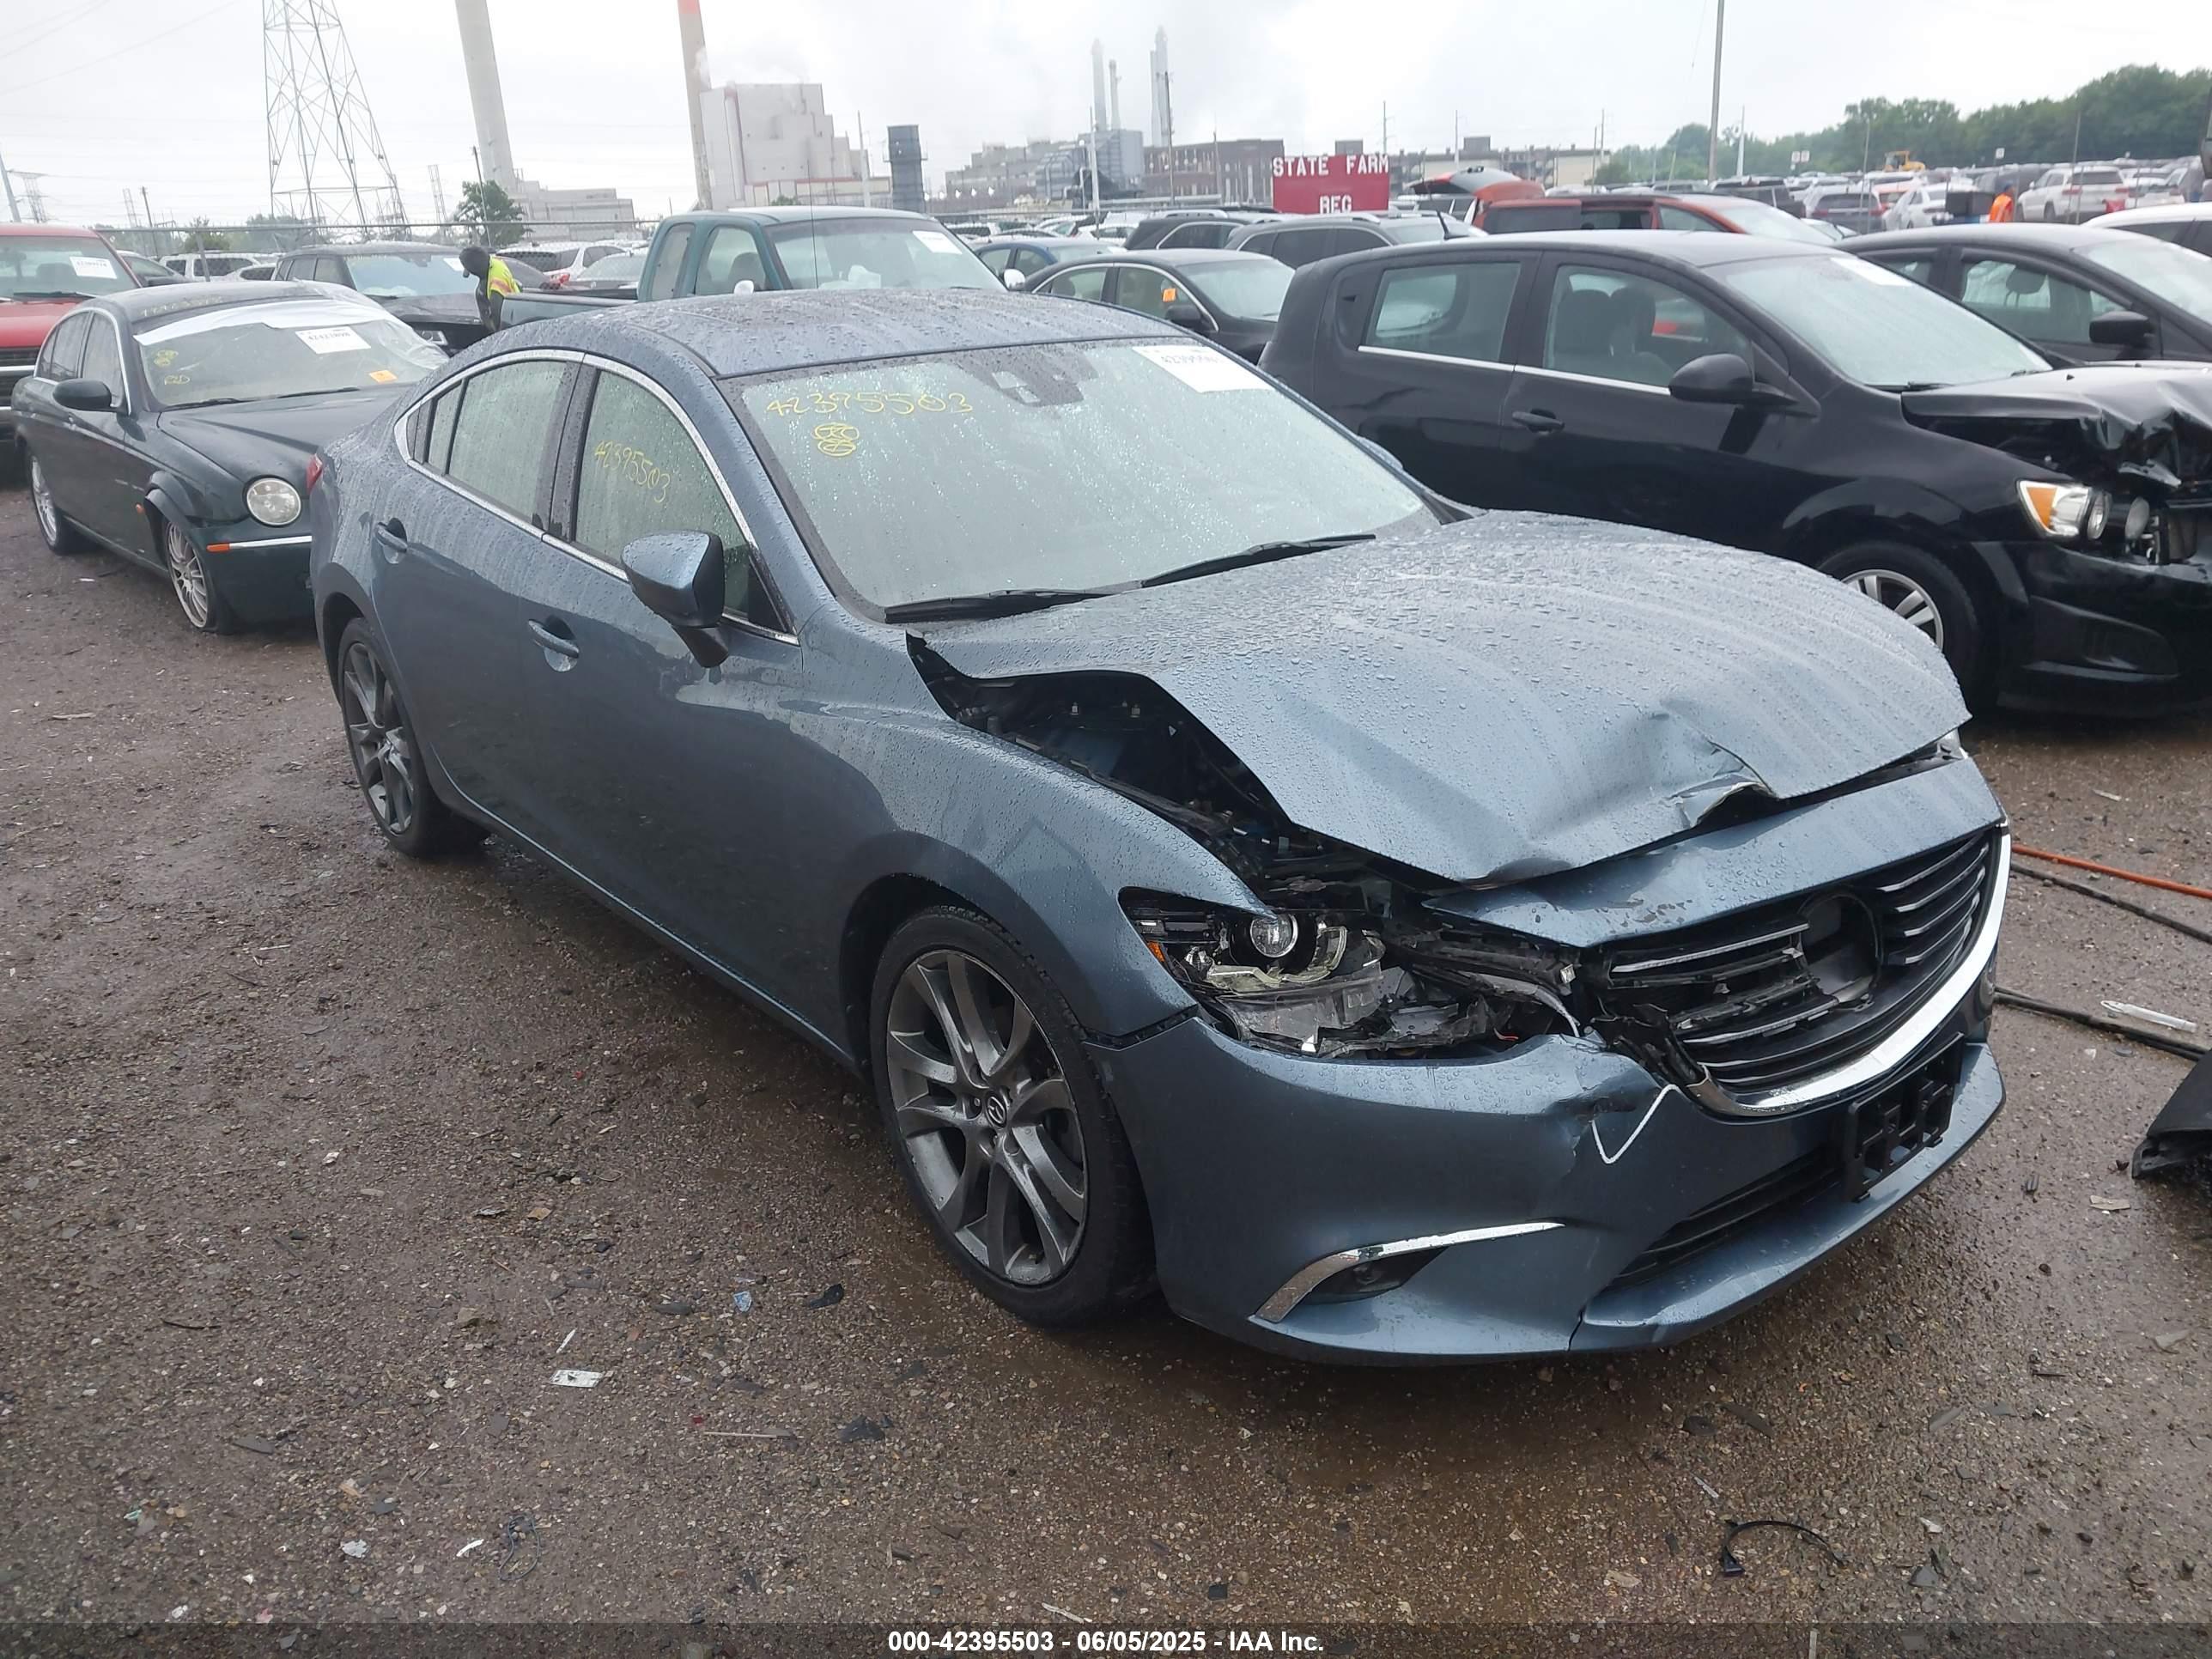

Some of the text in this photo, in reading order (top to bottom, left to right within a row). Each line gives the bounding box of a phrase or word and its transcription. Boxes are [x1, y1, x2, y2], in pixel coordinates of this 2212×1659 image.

[1273, 154, 1389, 178] STATE FARM
[1319, 194, 1352, 215] REG
[766, 392, 973, 416] 42395503
